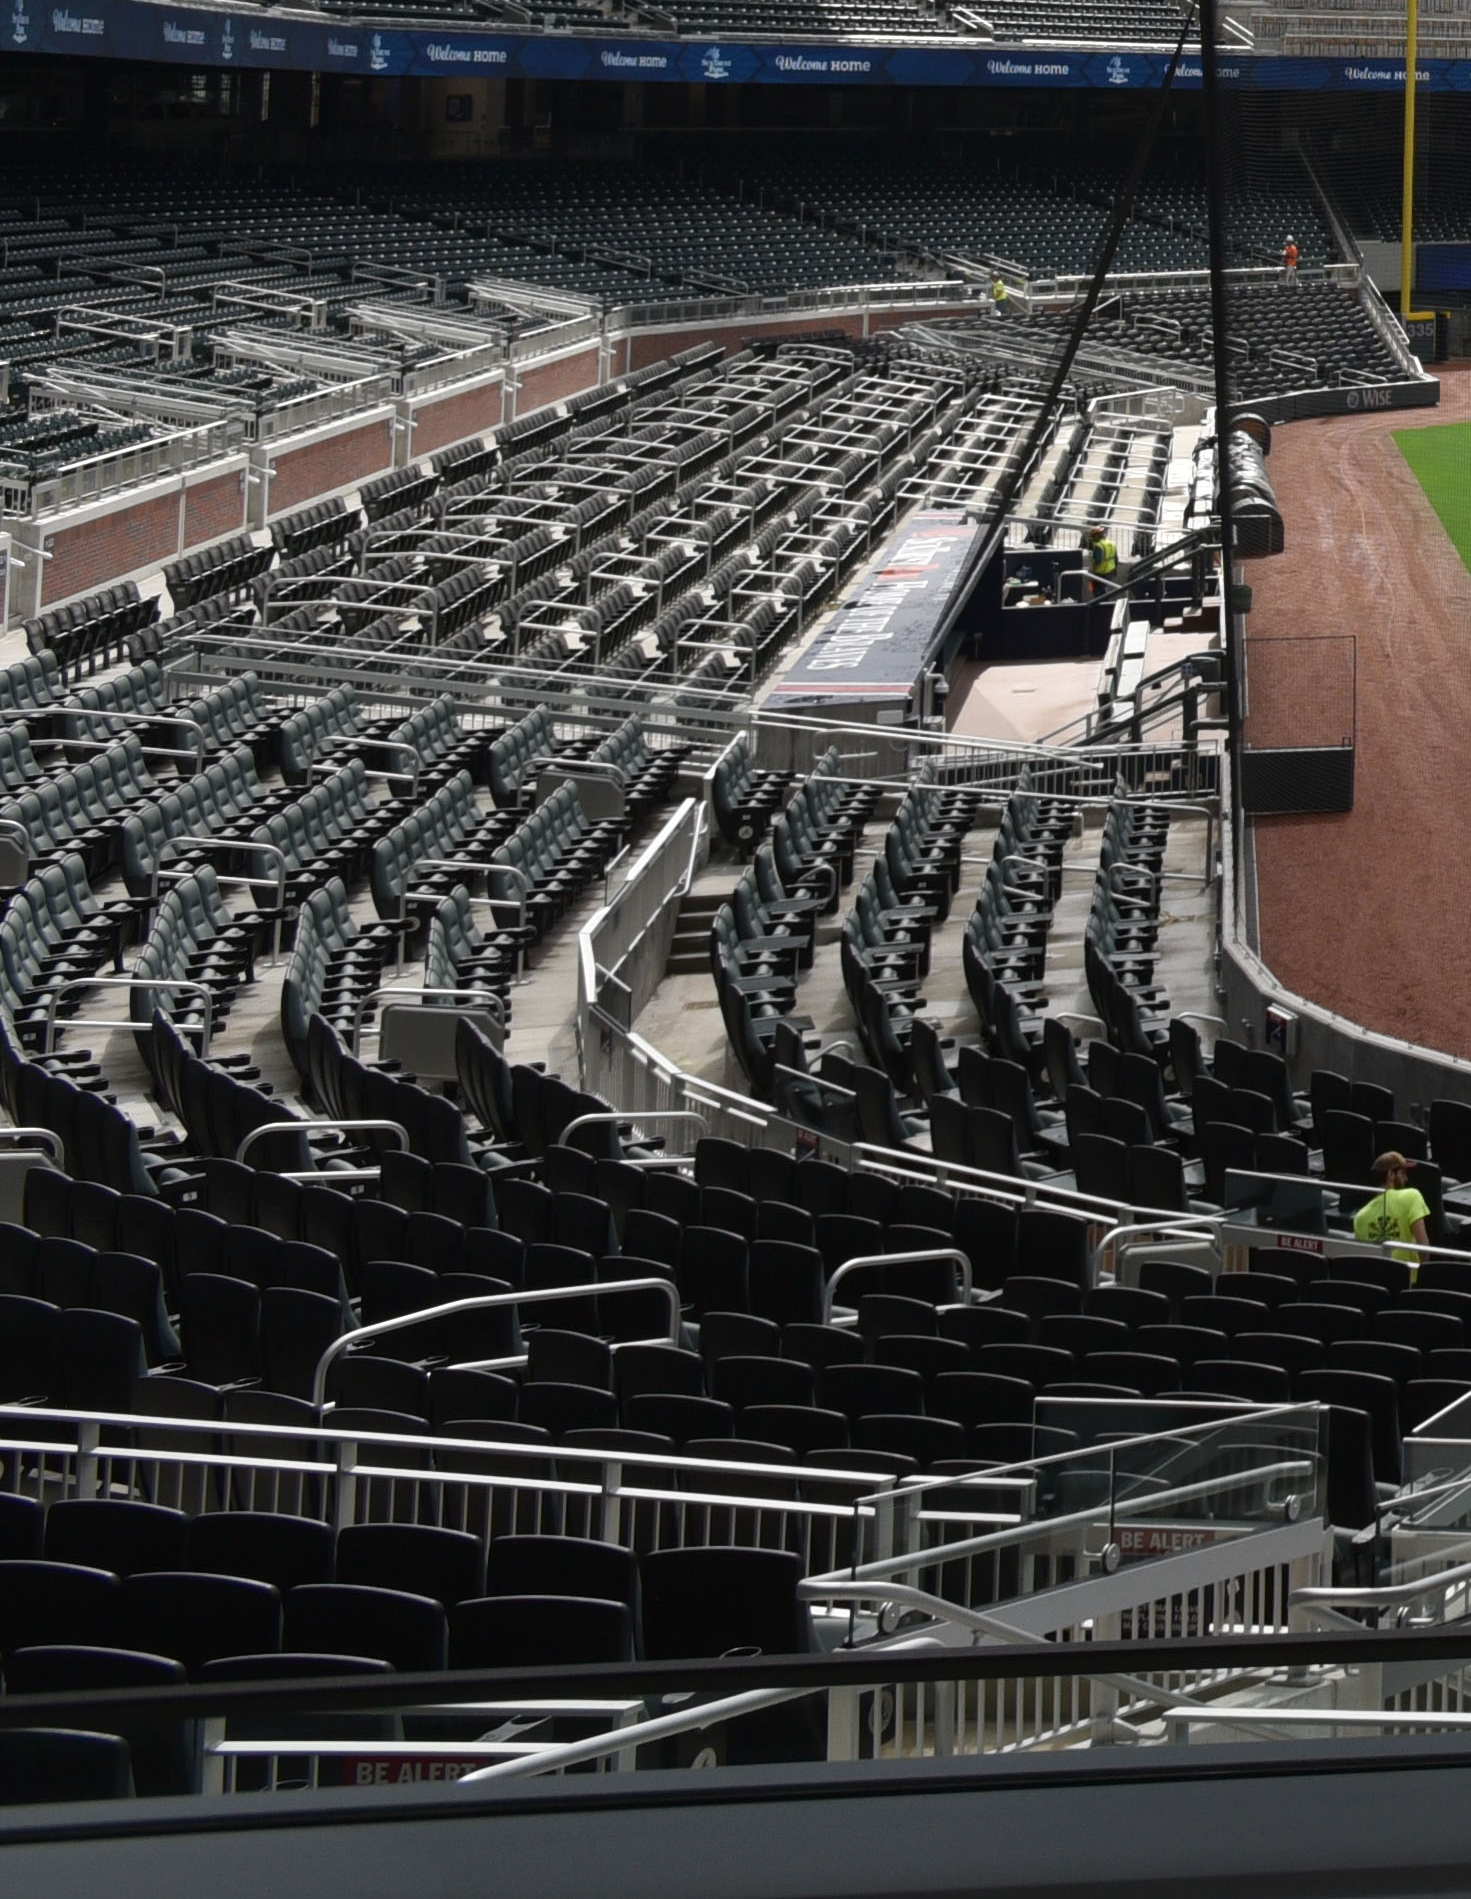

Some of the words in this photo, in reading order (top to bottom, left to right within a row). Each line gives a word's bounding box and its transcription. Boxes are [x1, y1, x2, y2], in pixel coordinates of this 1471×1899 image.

[775, 54, 828, 71] Welcome
[986, 59, 1033, 75] Welcome
[1344, 65, 1392, 82] Welcome
[1406, 322, 1435, 338] 335
[1120, 1531, 1145, 1549] BE
[1149, 1532, 1205, 1550] ALERT
[356, 1762, 391, 1784] BE
[398, 1762, 477, 1783] ALERT
